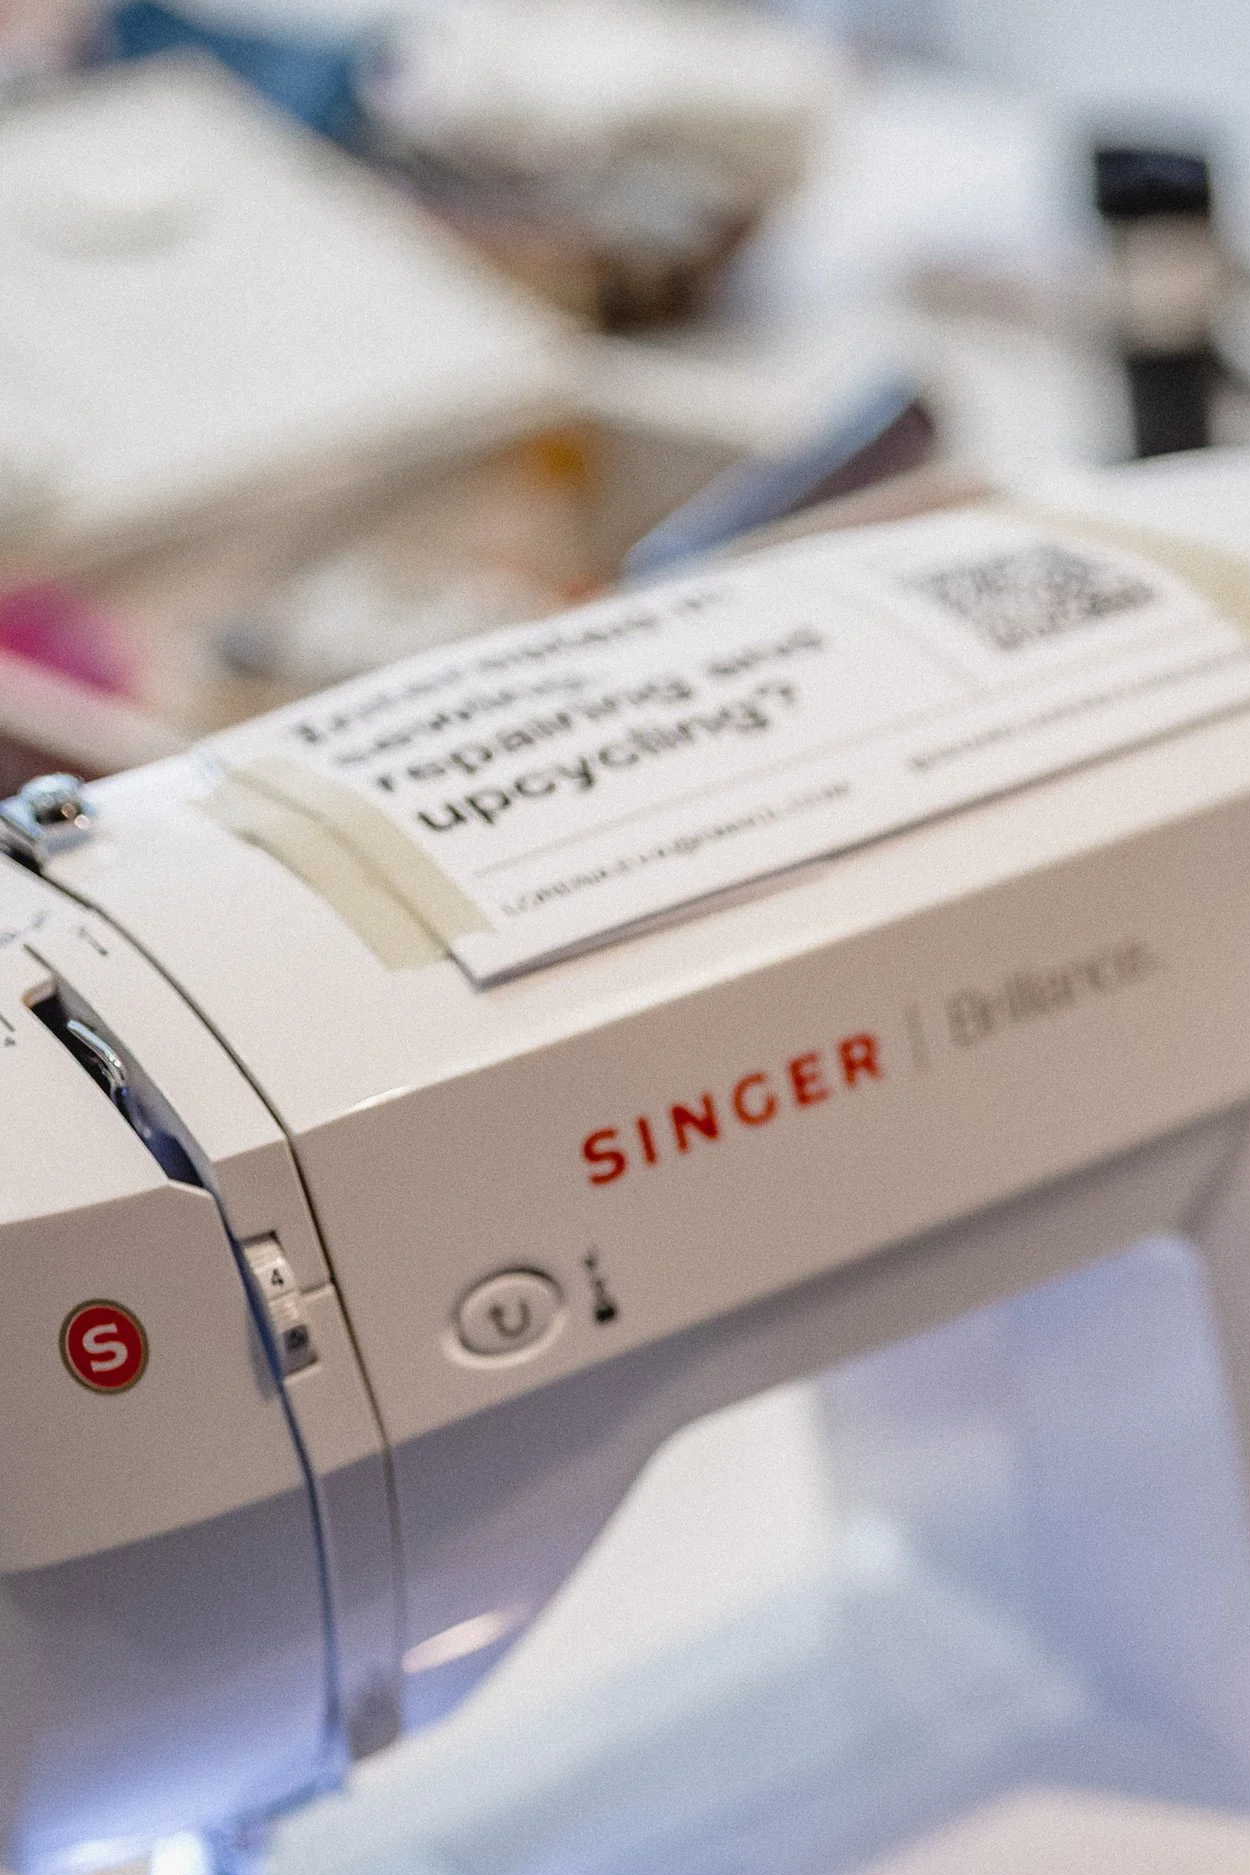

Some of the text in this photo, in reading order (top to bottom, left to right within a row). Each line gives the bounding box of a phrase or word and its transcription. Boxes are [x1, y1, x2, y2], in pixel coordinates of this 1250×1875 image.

[376, 672, 696, 794] repairing
[416, 678, 799, 834] upcycling?
[581, 1030, 885, 1186] SINGER
[270, 1267, 285, 1287] 4
[82, 1323, 129, 1373] S
